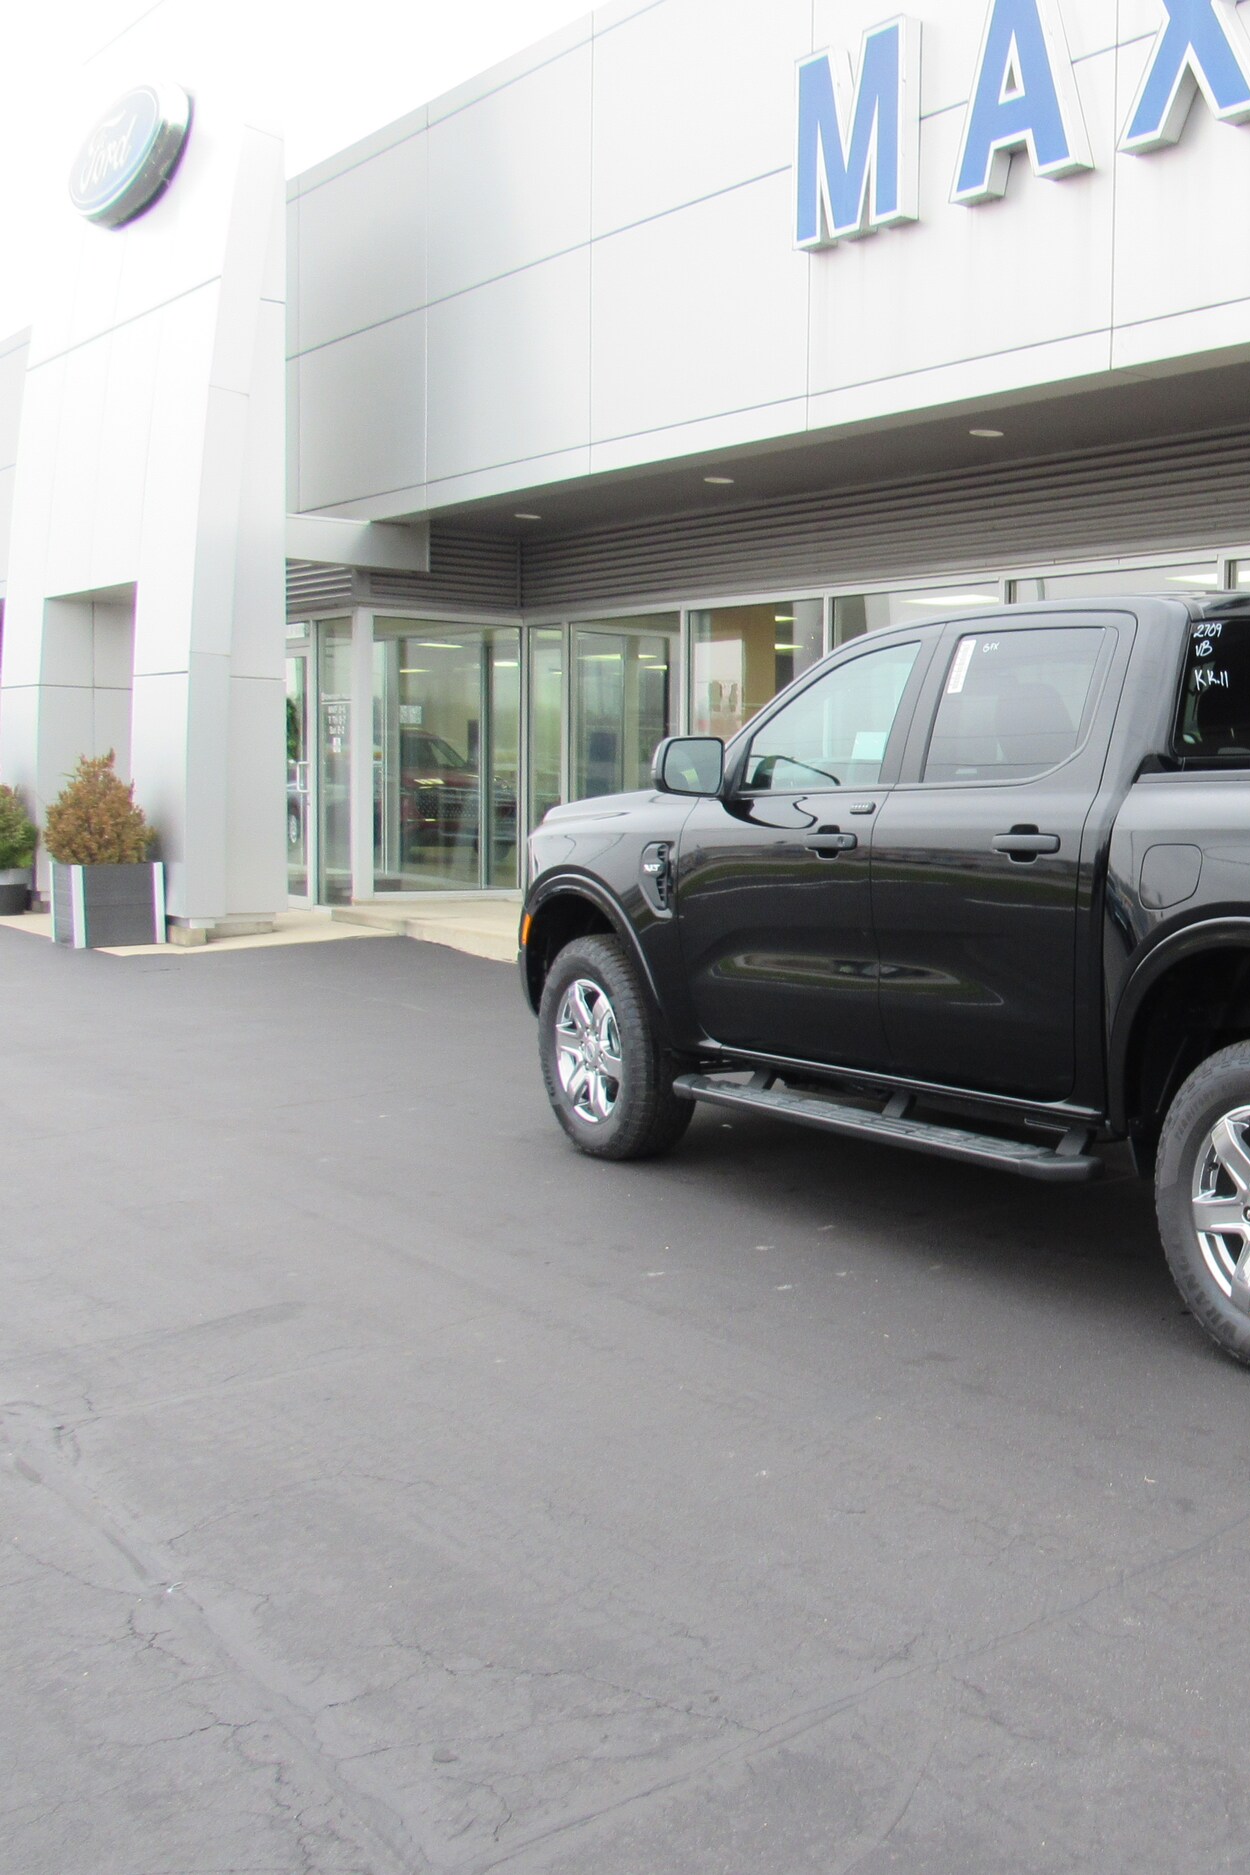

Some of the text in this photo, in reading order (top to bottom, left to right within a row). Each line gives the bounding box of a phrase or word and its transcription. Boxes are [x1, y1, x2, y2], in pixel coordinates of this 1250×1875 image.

[79, 108, 138, 195] Ford
[1193, 623, 1223, 638] 2709
[1195, 640, 1213, 657] VB
